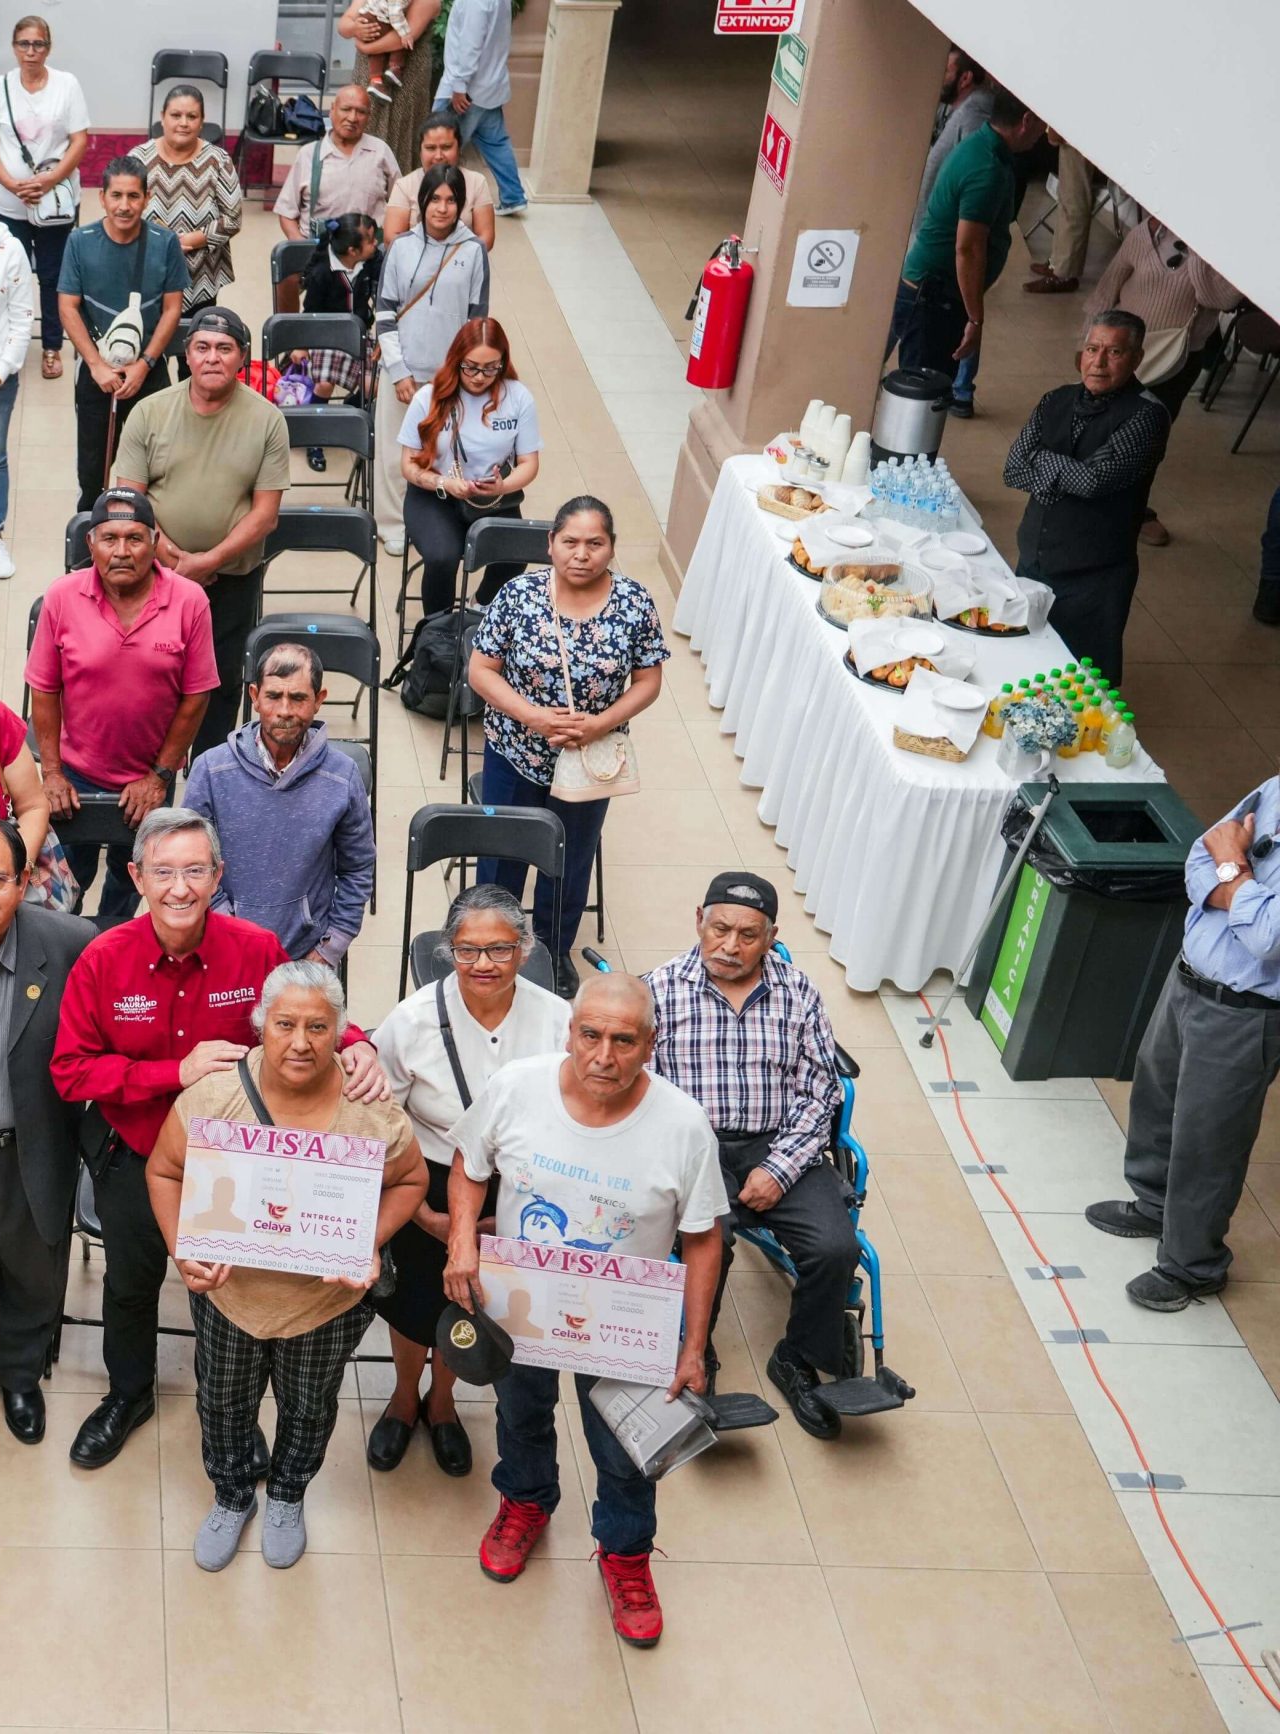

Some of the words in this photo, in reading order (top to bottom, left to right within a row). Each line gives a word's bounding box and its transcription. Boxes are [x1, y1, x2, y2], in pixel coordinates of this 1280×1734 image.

[719, 15, 790, 27] EXTINTOR
[492, 419, 518, 431] 2007
[1002, 872, 1044, 1000] ORGÁNICA
[123, 994, 147, 1002] TOÑO
[209, 987, 255, 1003] morena
[113, 1001, 157, 1009] CHAURAND
[239, 1127, 326, 1160] VISA
[589, 1194, 626, 1209] MEXICO
[301, 1212, 342, 1222] ENTREGA
[253, 1219, 292, 1233] Celaya
[300, 1221, 356, 1240] VISAS
[532, 1247, 623, 1280] VISA
[551, 1328, 591, 1341] Celaya
[600, 1324, 643, 1335] ENTREGA
[599, 1332, 657, 1351] VISAS
